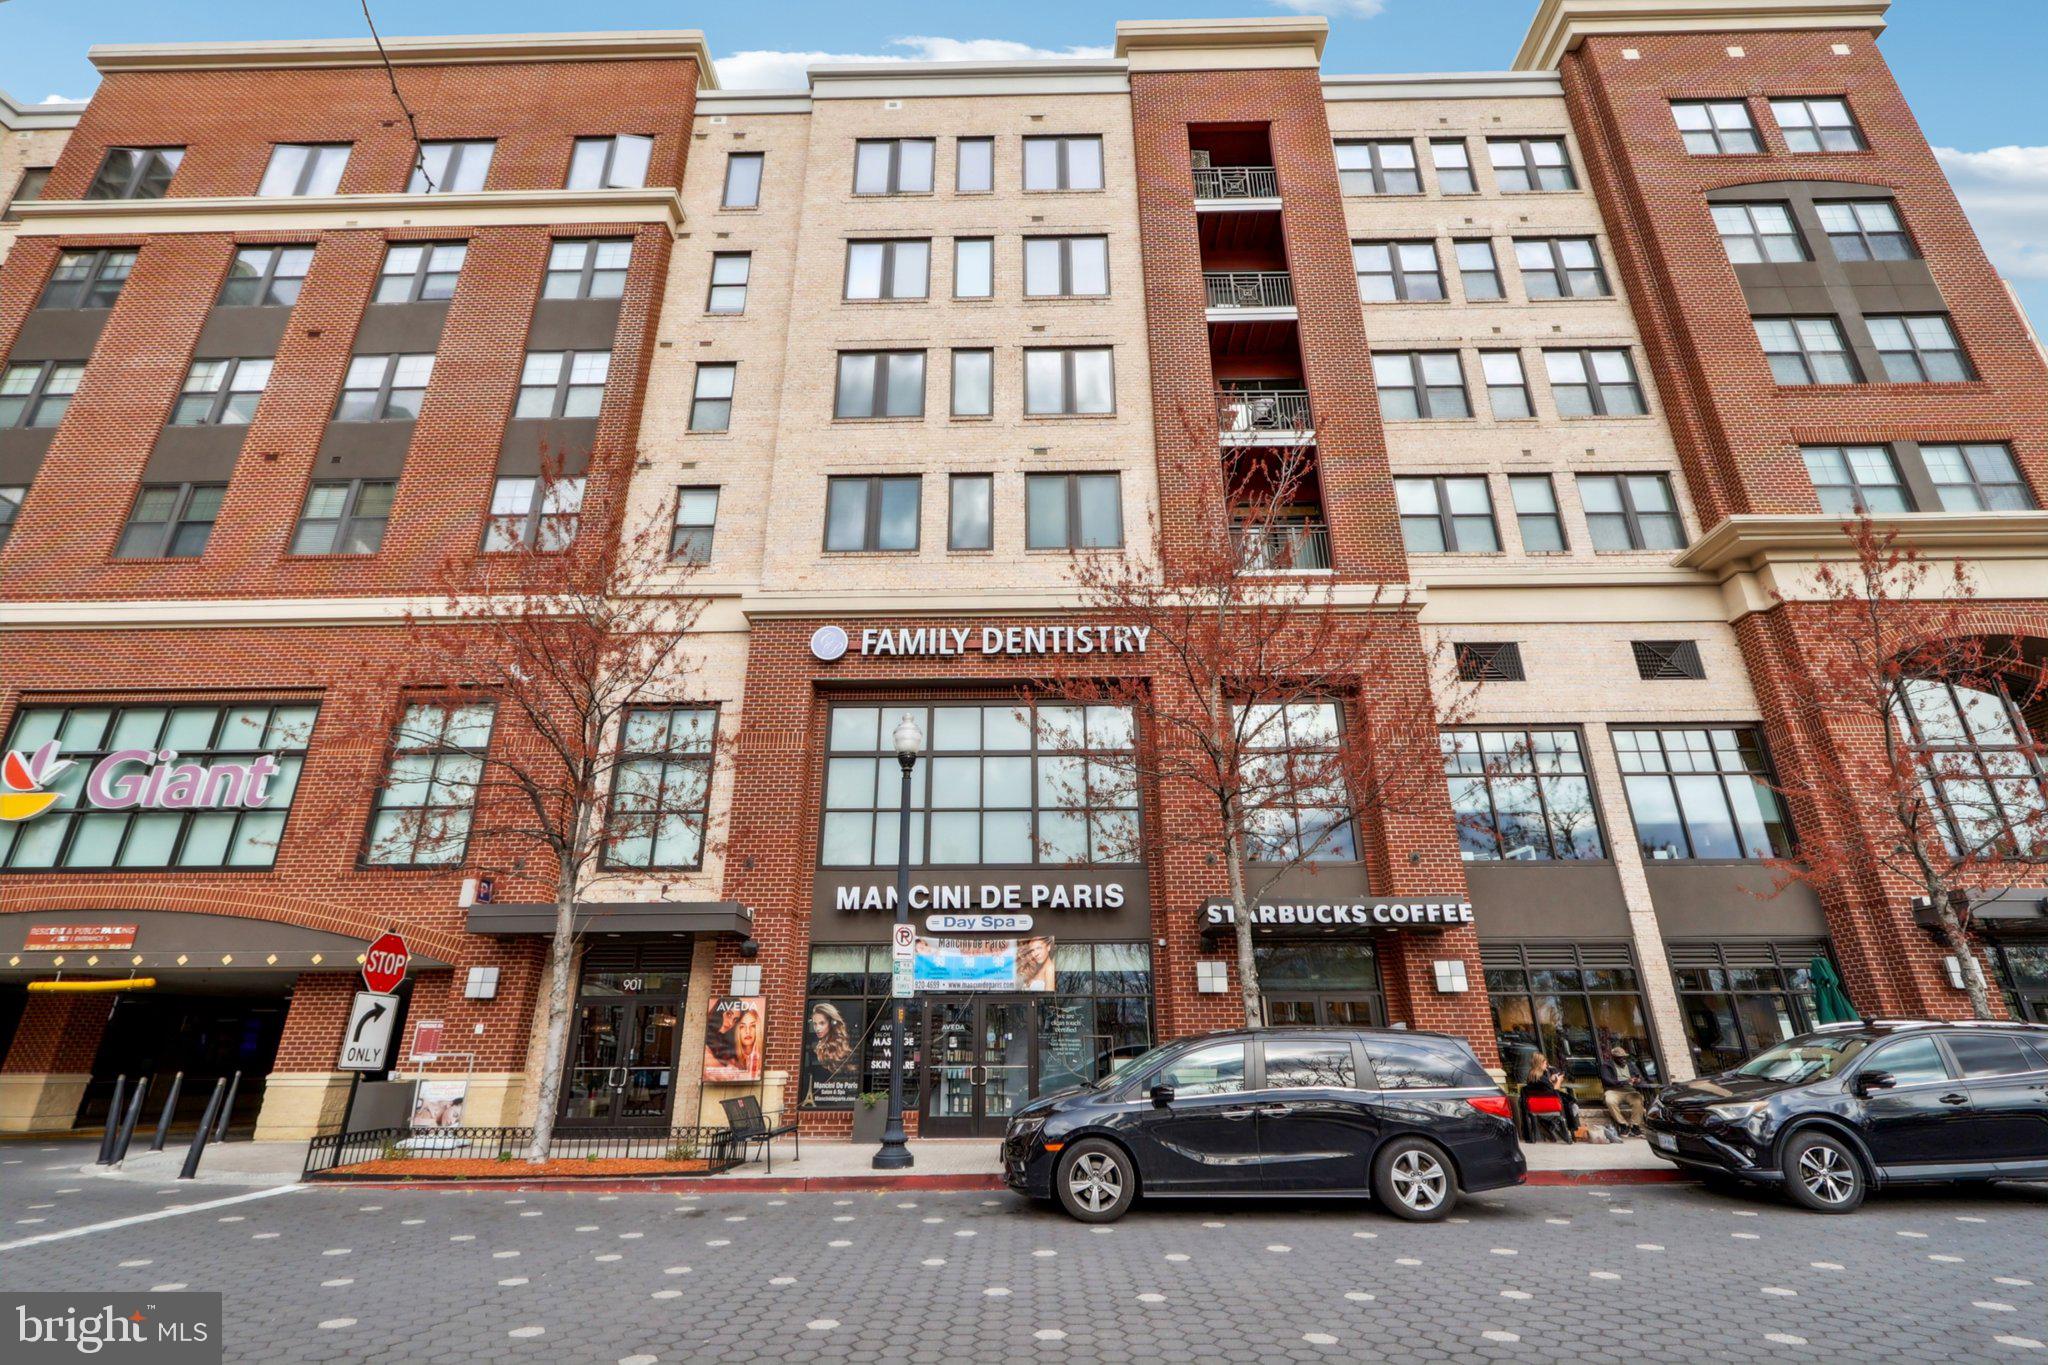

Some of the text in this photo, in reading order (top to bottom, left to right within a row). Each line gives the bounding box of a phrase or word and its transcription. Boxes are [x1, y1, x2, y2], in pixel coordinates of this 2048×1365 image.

[861, 628, 971, 655] FAMILY
[982, 625, 1151, 654] DENTISTRY
[87, 750, 280, 808] Giant
[836, 883, 1124, 910] MANCINI DE PARIS
[1373, 903, 1475, 922] COFFEE
[943, 916, 1016, 929] Day Spa
[367, 950, 406, 975] STOP
[623, 979, 642, 990] 901
[717, 1001, 758, 1011] AVEDA
[347, 1047, 382, 1061] ONLY
